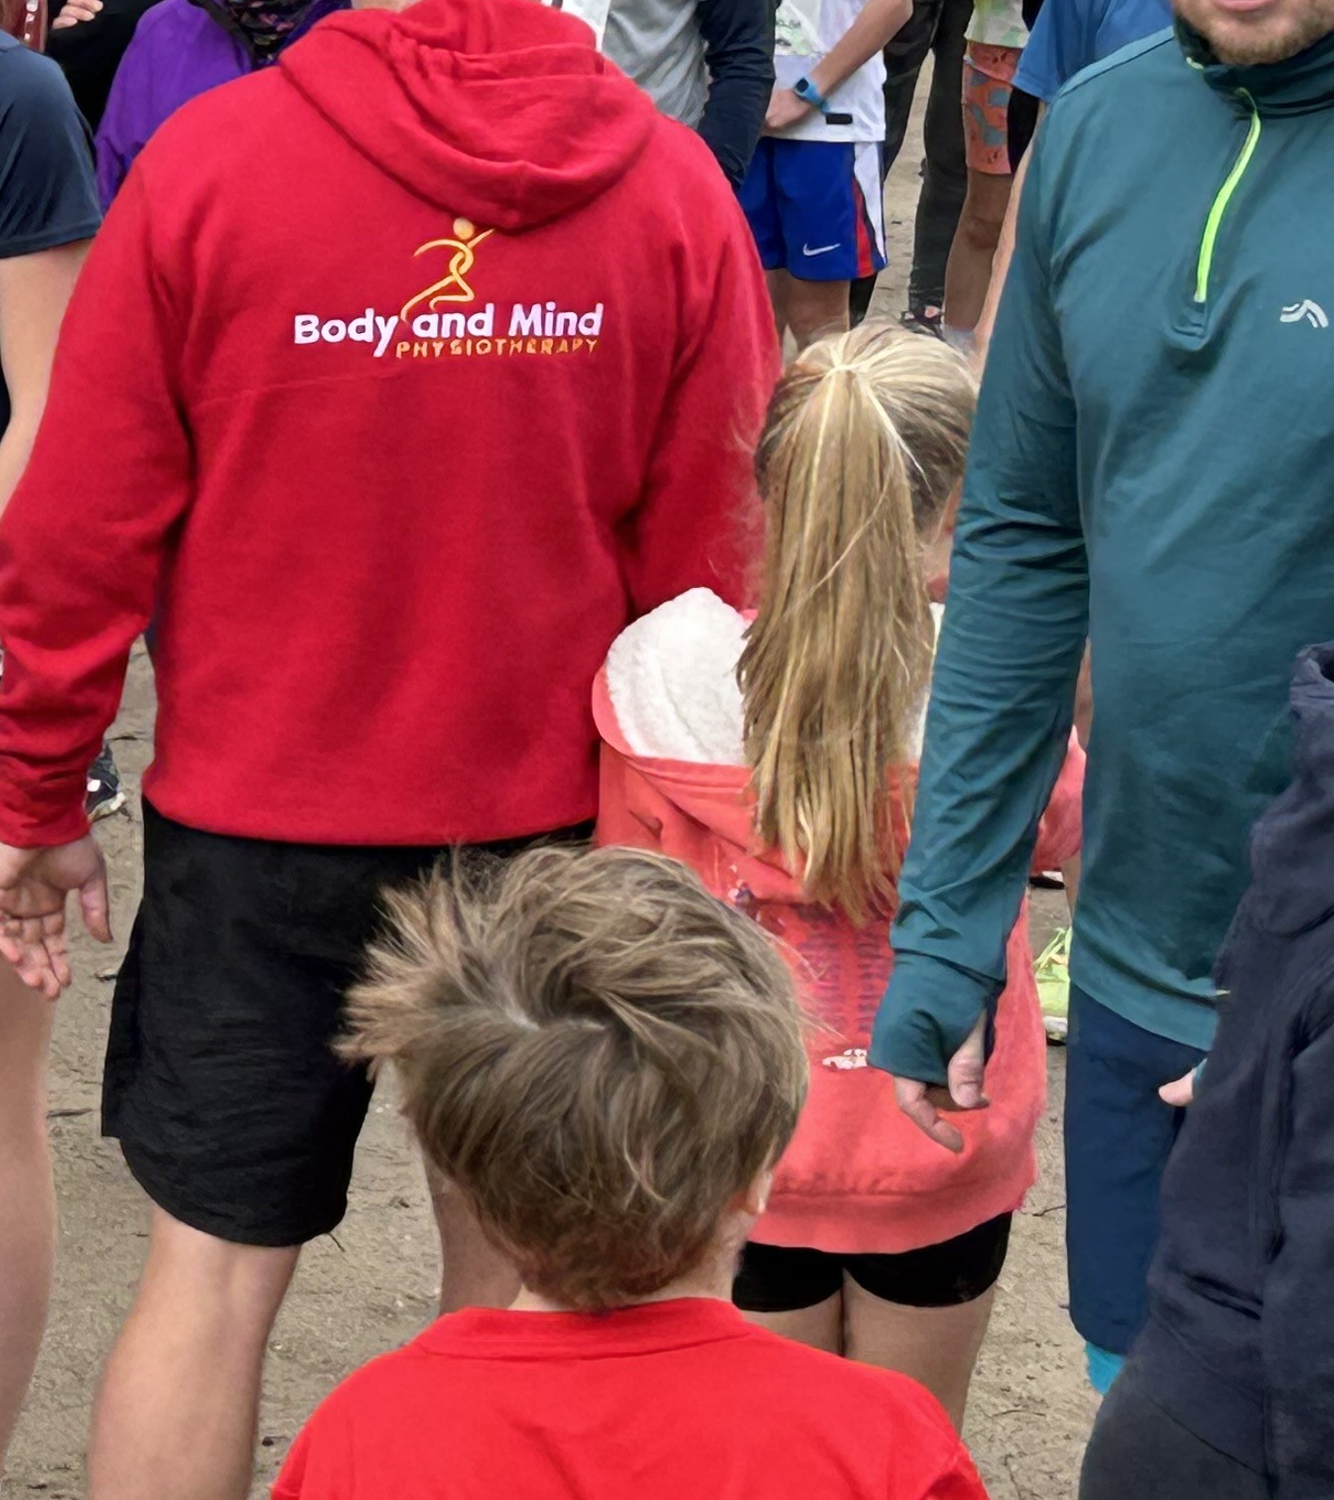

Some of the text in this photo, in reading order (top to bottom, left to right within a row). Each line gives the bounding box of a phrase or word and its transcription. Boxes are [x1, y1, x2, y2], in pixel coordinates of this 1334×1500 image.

[294, 301, 604, 358] Body and Mind
[395, 338, 599, 359] PHYSIOTHERAPY
